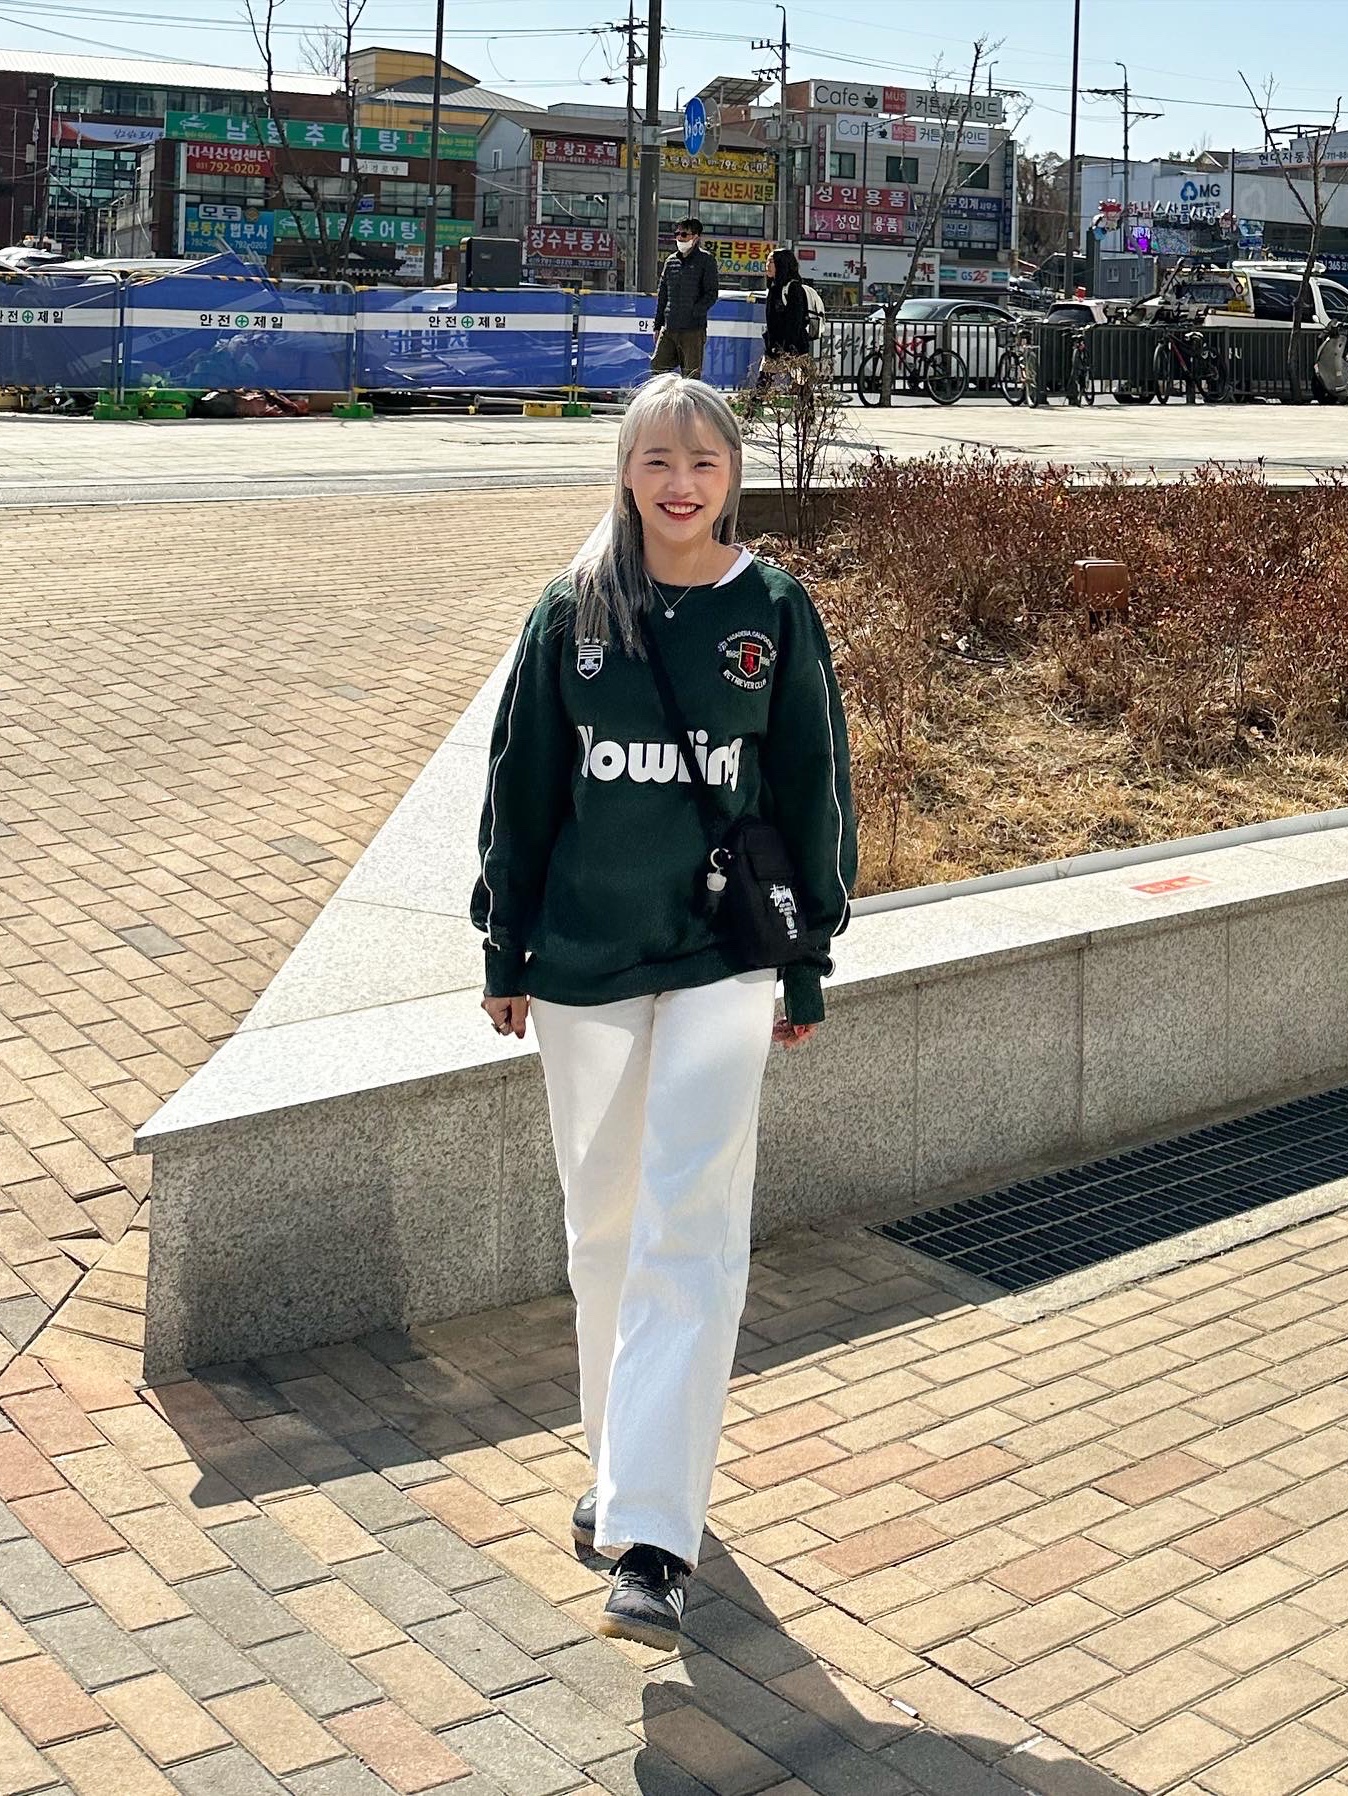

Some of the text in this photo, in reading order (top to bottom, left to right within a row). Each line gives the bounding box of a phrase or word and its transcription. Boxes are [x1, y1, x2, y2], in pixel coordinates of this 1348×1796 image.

[815, 85, 859, 106] Cafe
[187, 144, 271, 163] 지식산업센터
[1259, 151, 1312, 166] 현대자동
[210, 161, 261, 174] 792-0202
[816, 185, 907, 208] 성인용품
[1200, 184, 1221, 198] MG
[201, 205, 239, 219] 모두
[186, 221, 269, 240] 부동산 법무사
[835, 214, 860, 231] 성인
[873, 216, 898, 233] 용품
[531, 229, 611, 252] 장수부동산
[961, 270, 989, 284] GS25
[37, 310, 63, 324] 제일
[200, 313, 283, 329] 안전 제일
[428, 315, 506, 329] 안전 제일
